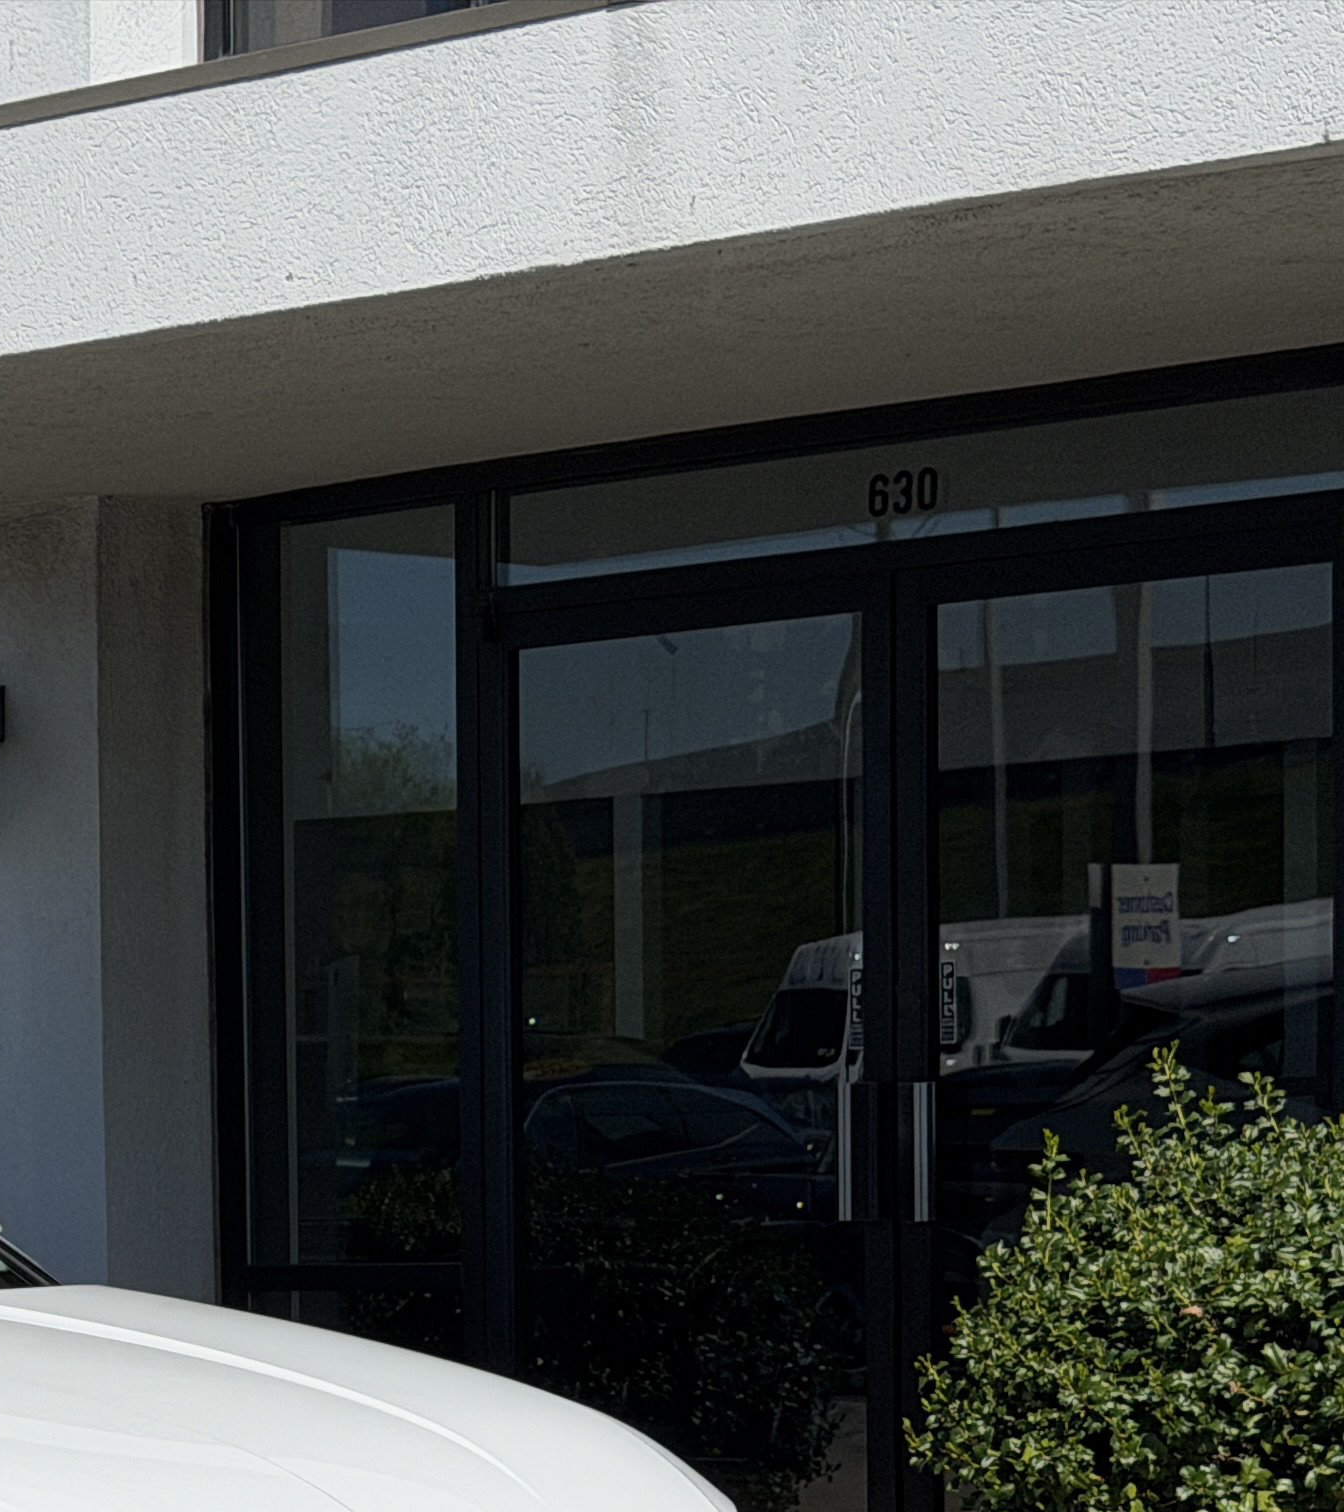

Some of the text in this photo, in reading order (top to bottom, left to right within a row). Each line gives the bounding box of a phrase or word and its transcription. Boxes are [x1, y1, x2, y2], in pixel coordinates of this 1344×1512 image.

[868, 466, 938, 517] 630
[851, 970, 863, 1023] PULL
[942, 963, 954, 1017] PULL
